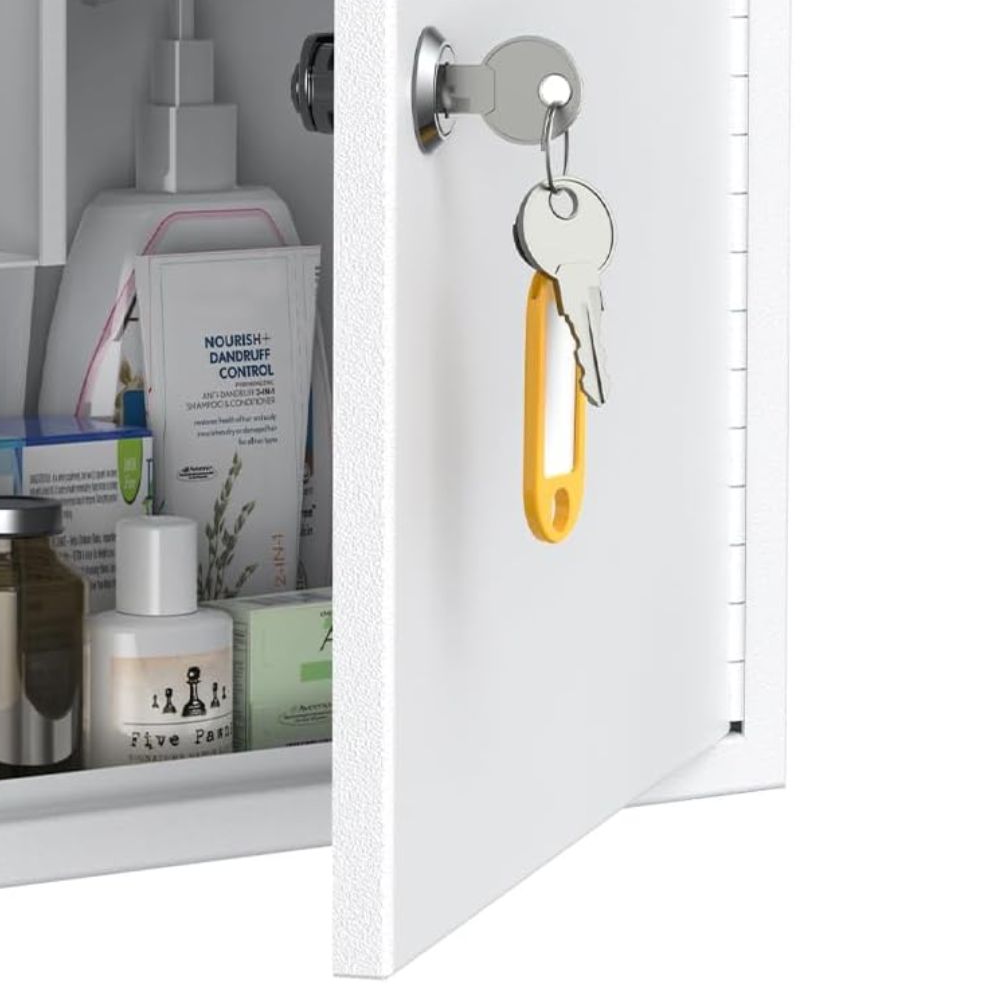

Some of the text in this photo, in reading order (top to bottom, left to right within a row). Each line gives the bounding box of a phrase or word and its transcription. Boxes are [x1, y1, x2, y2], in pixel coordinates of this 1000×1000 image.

[209, 348, 271, 364] DANDRUFF
[219, 364, 275, 380] CONTROL
[130, 730, 180, 750] Five
